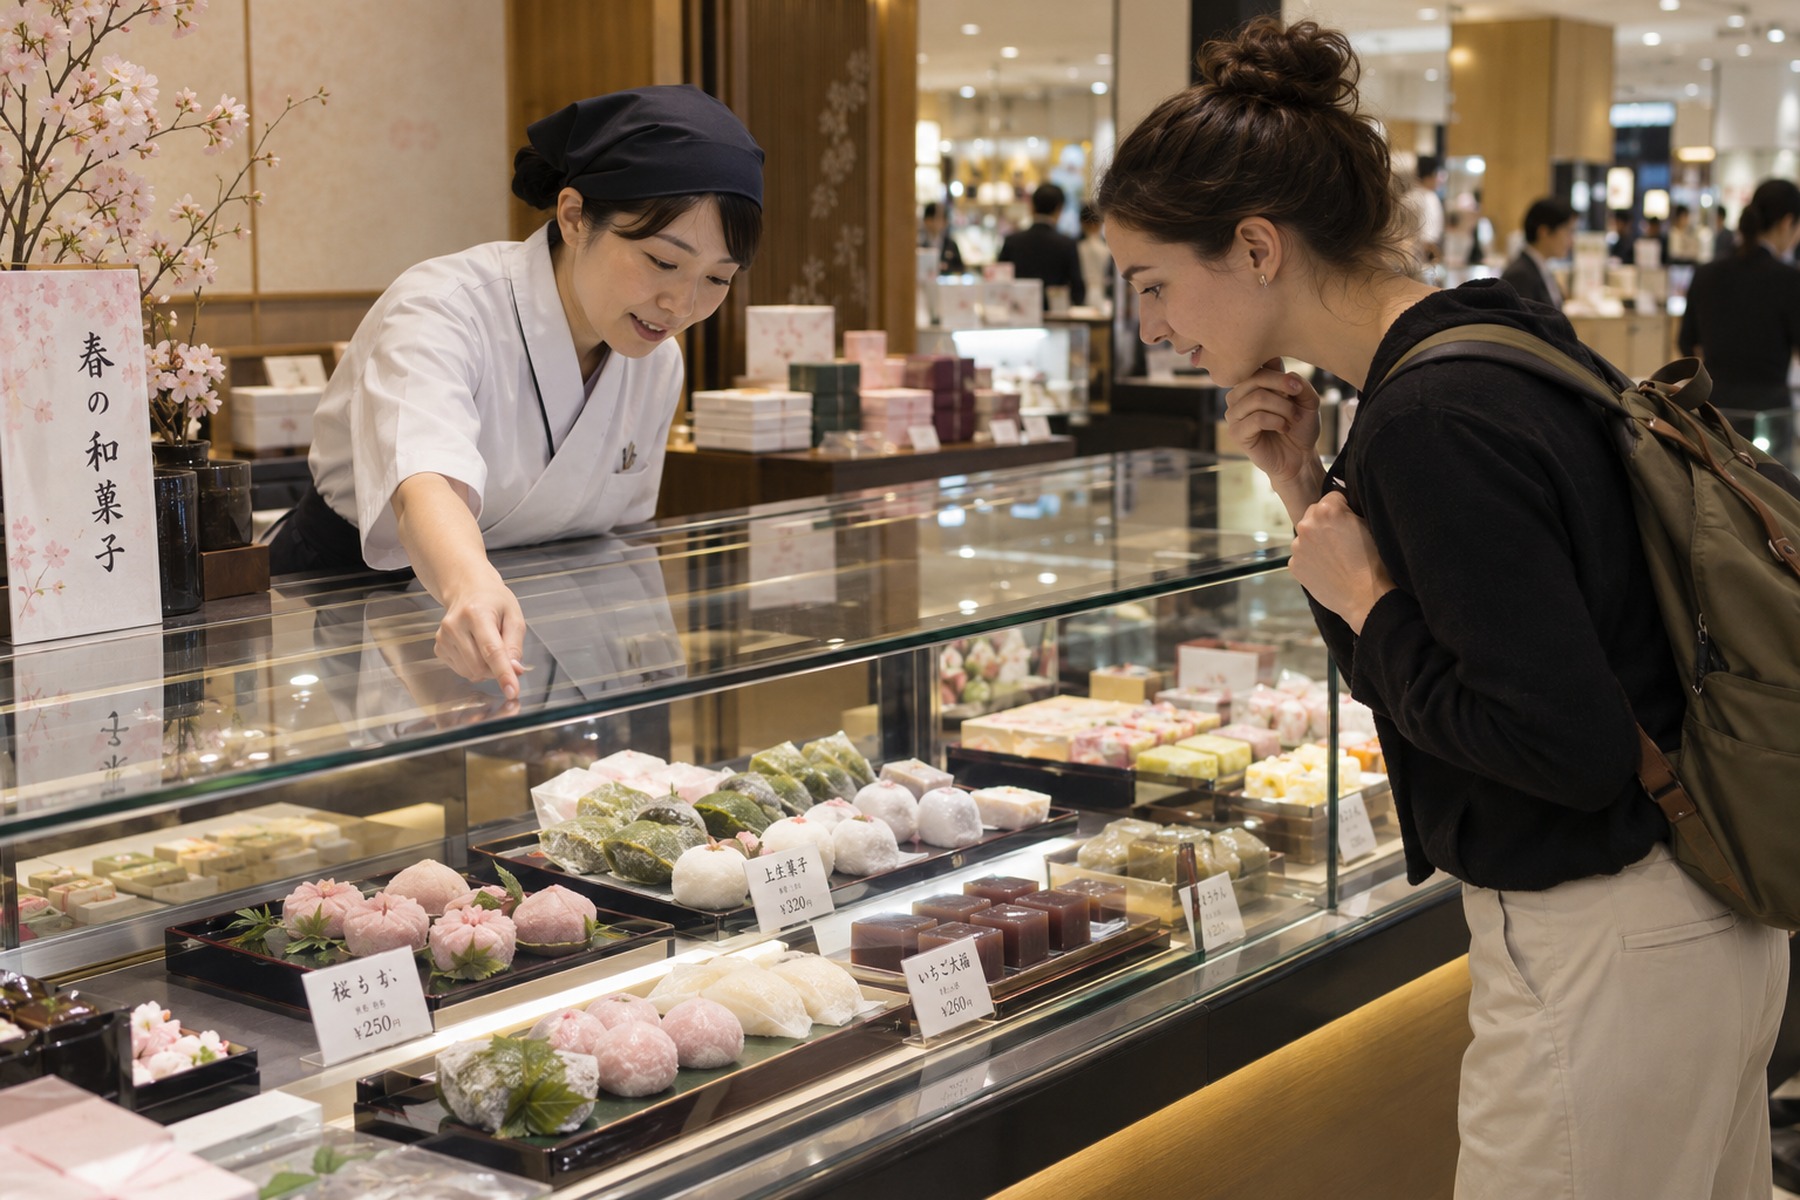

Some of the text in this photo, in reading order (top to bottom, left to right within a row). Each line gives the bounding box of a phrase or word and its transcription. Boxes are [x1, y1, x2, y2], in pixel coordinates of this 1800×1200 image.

[77, 331, 125, 573] 春の和菓子
[764, 856, 808, 884] 上生菓子
[779, 895, 813, 915] ¥320円
[918, 951, 971, 984] いちご大福
[940, 995, 974, 1018] ¥260円
[353, 1014, 401, 1041] ¥250円
